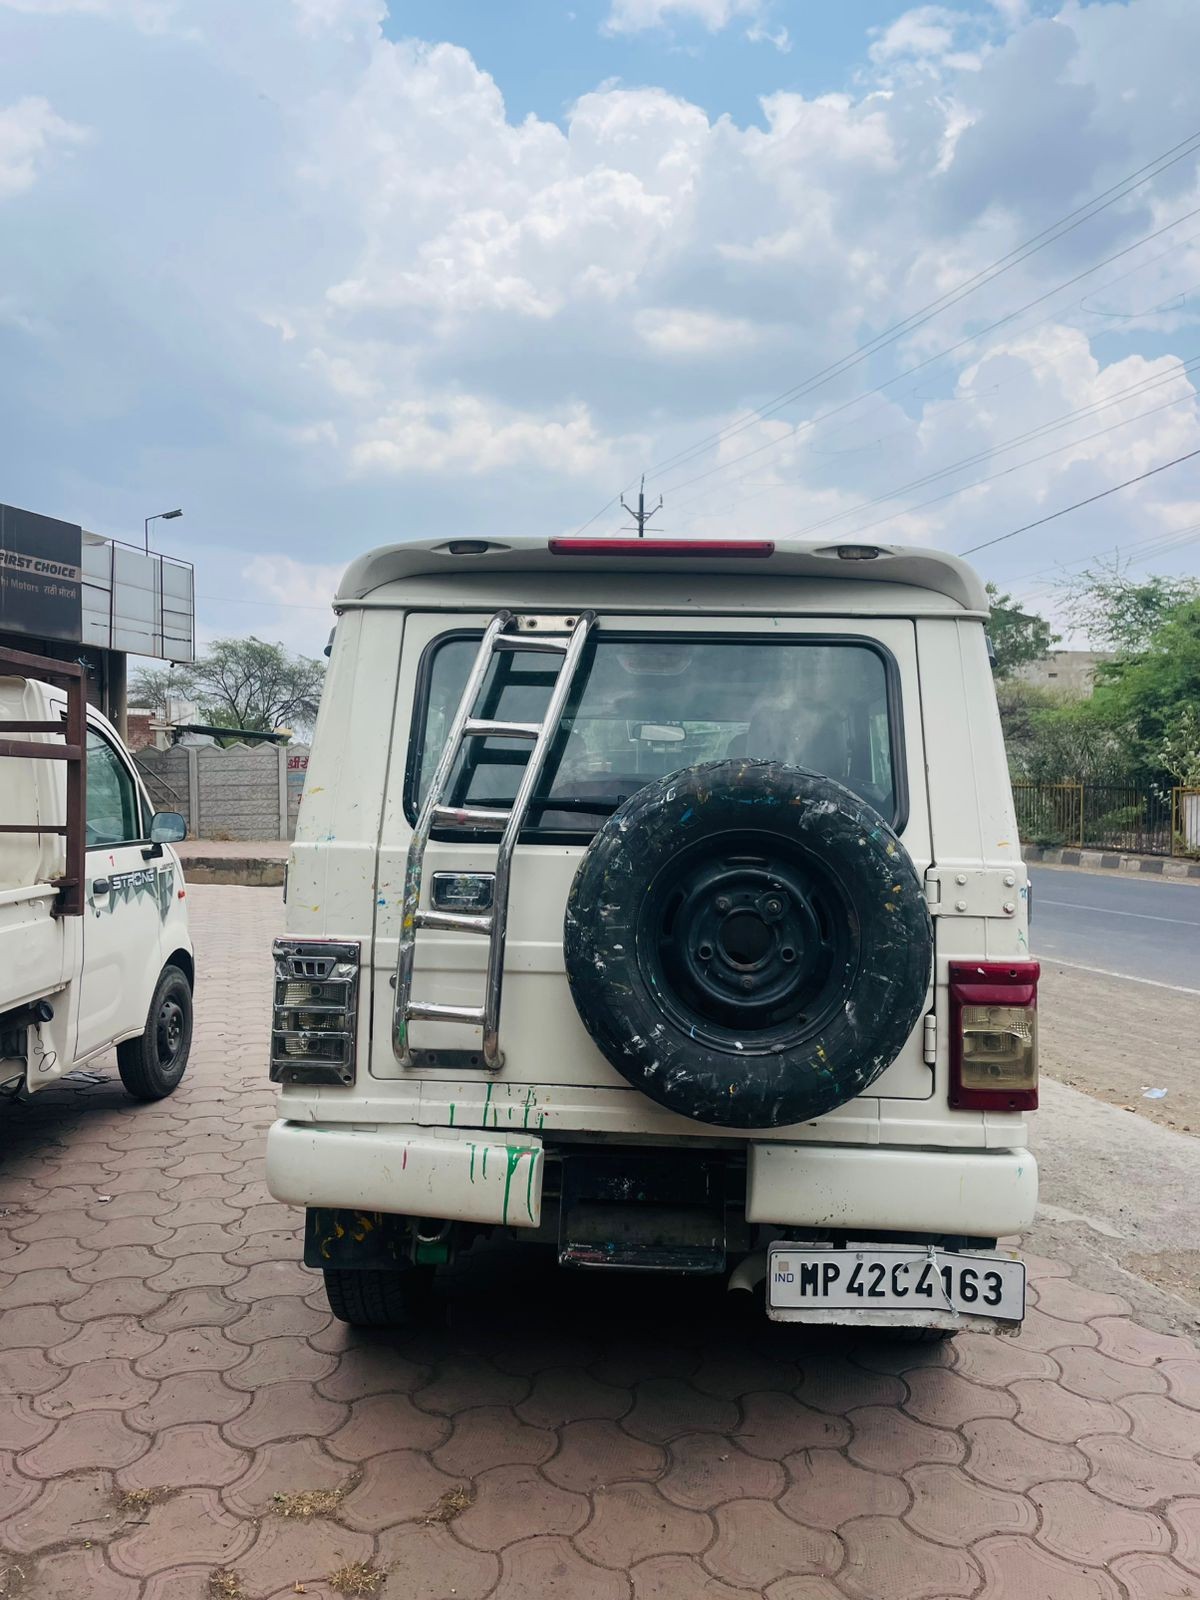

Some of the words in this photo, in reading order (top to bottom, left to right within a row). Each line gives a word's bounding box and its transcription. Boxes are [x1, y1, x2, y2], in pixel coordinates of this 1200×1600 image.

[34, 561, 76, 579] CHOICE
[10, 578, 39, 593] Motors
[112, 868, 154, 891] STRONG
[774, 1272, 795, 1284] IND
